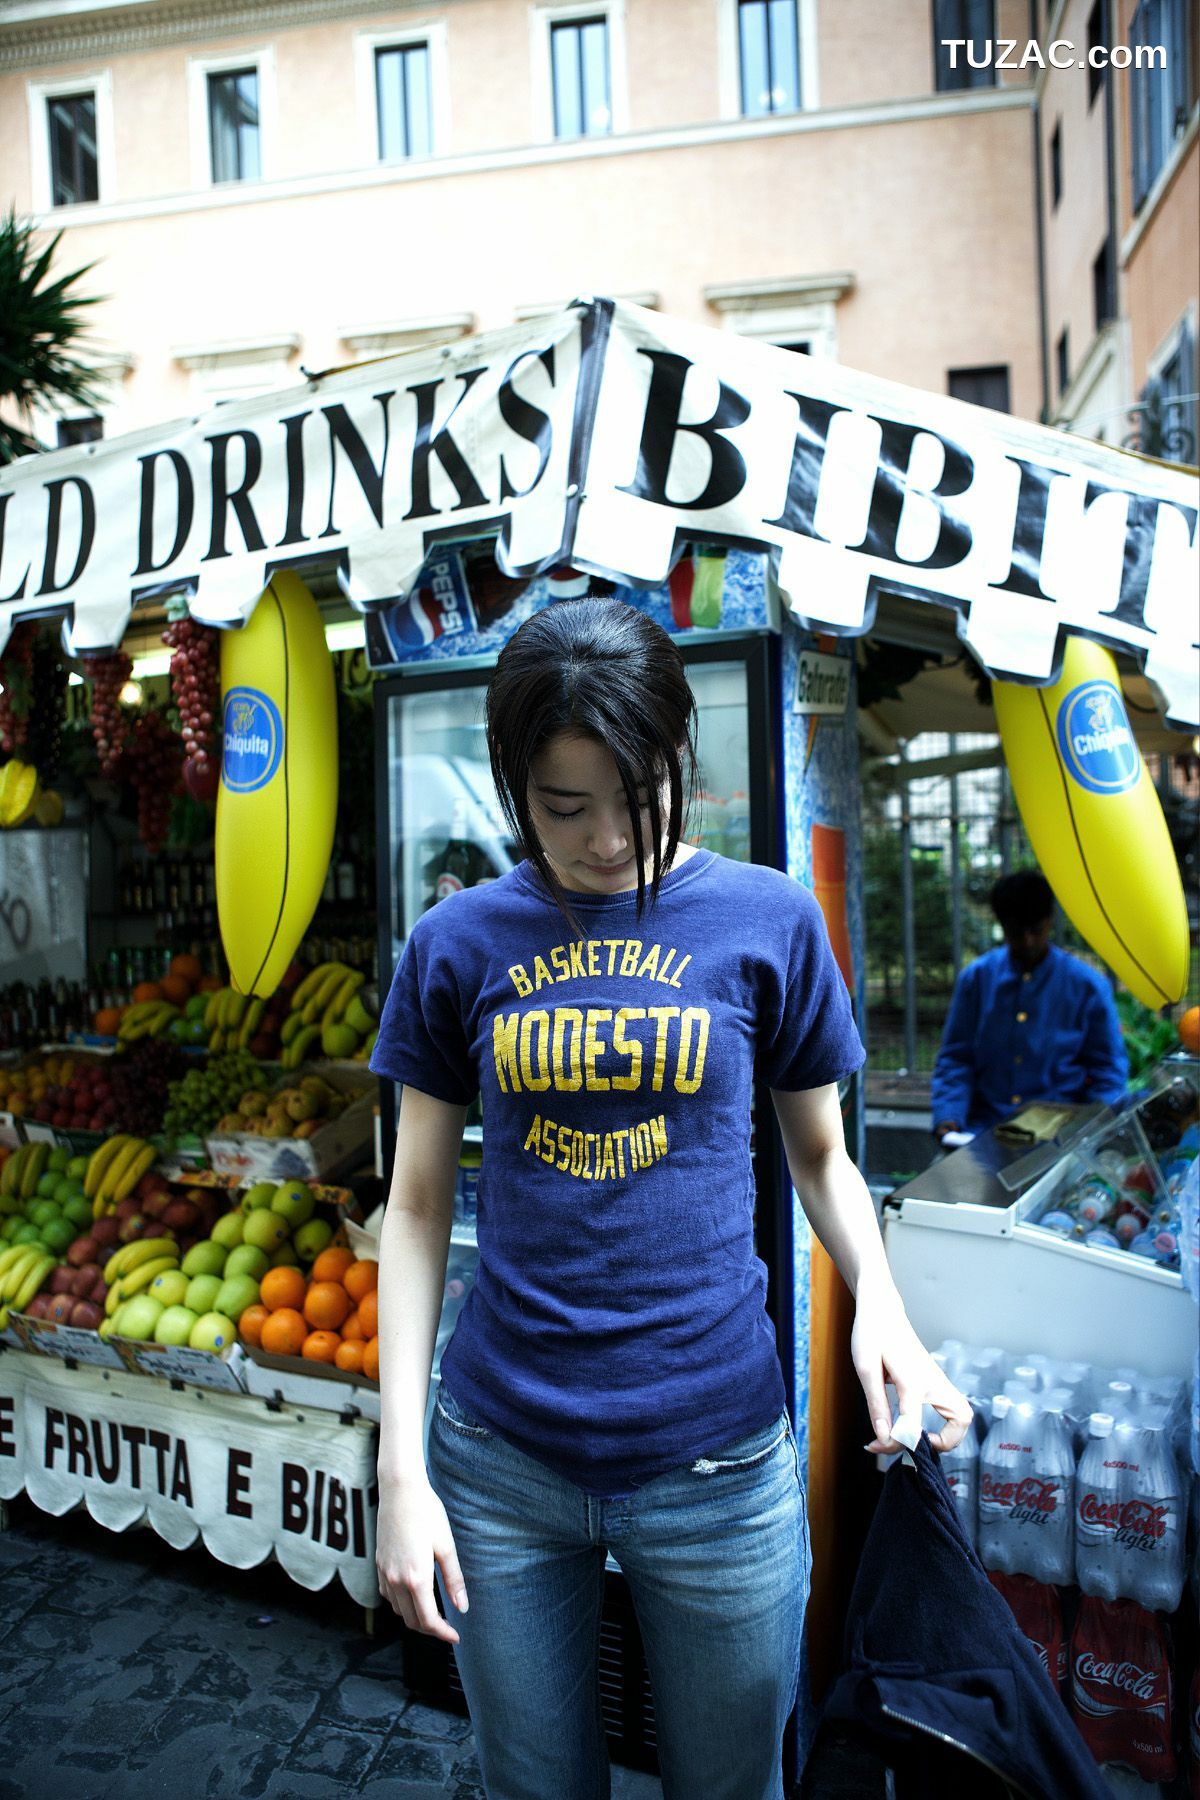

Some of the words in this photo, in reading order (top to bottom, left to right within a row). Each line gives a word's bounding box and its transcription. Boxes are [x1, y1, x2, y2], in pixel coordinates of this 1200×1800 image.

[131, 345, 556, 576] DRINKS
[616, 348, 1200, 640] BIBIT
[429, 561, 465, 636] PEPSI
[224, 733, 269, 758] Chiquita
[508, 939, 693, 998] BASKETBALL
[492, 1007, 711, 1094] MODESTO
[524, 1114, 669, 1180] ASSOCIATION
[45, 1406, 193, 1508] FRUTTA
[227, 1448, 253, 1520] E
[1008, 1502, 1049, 1527] light
[1112, 1526, 1158, 1552] light
